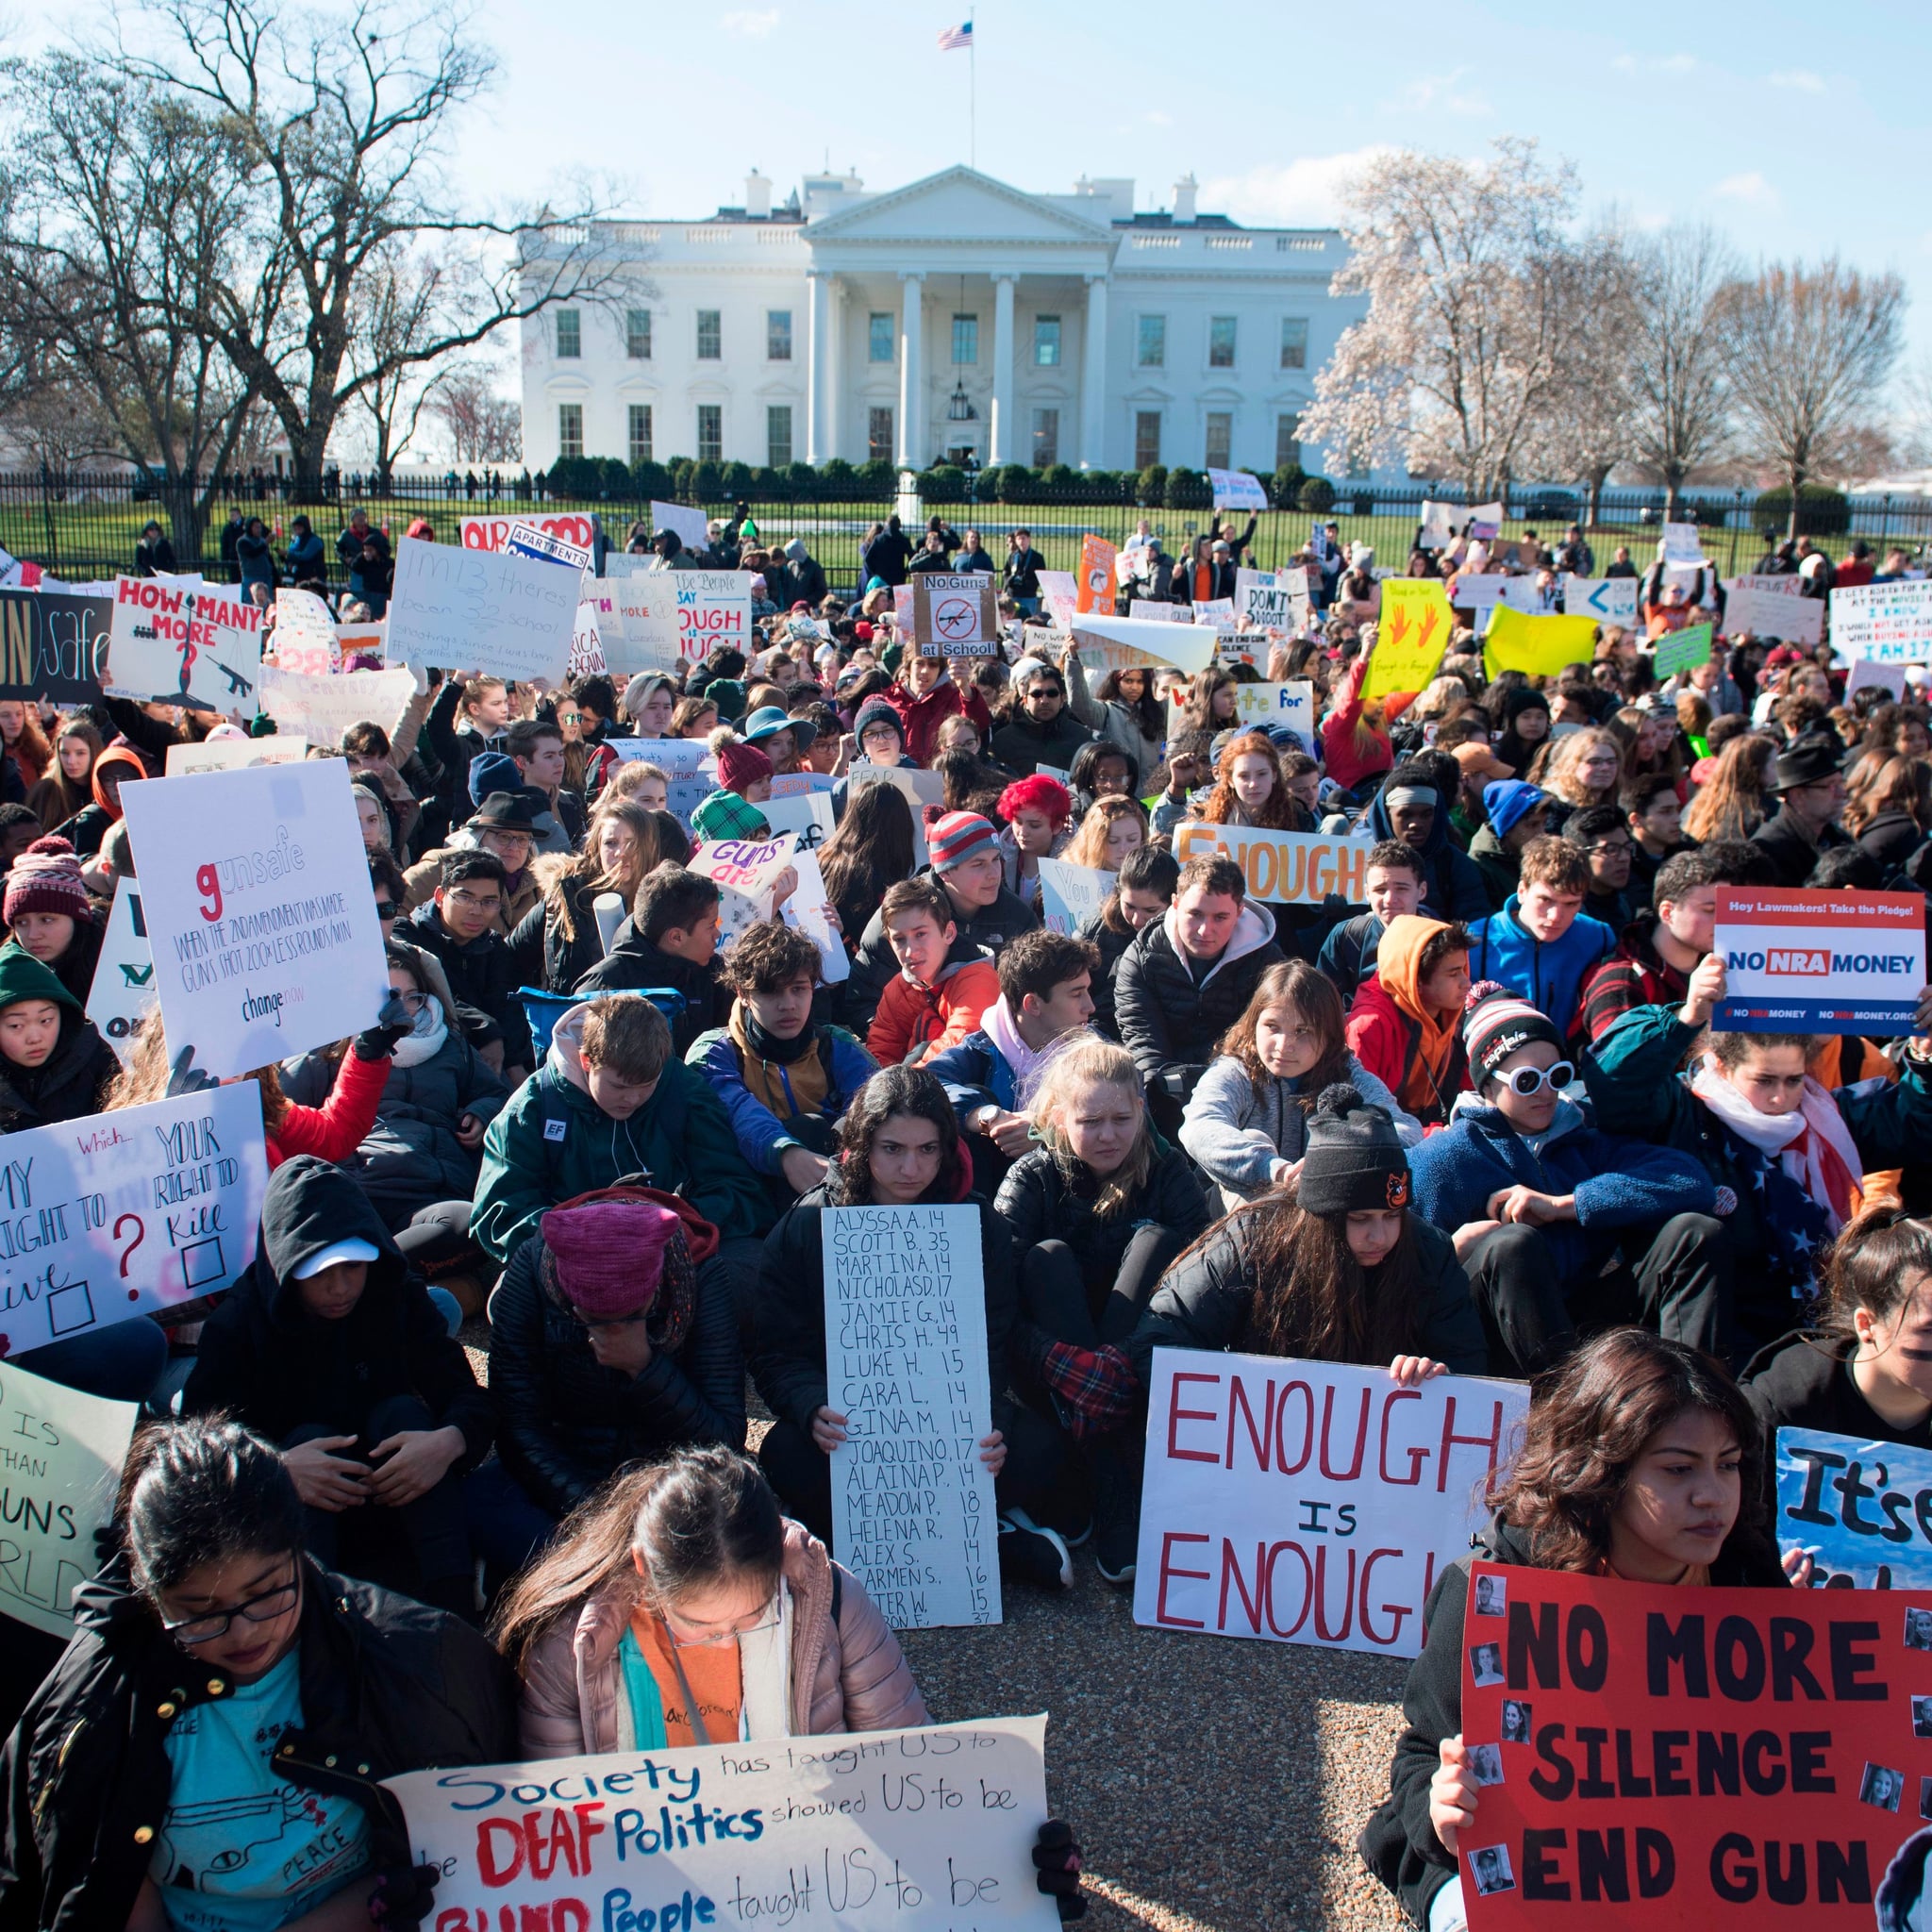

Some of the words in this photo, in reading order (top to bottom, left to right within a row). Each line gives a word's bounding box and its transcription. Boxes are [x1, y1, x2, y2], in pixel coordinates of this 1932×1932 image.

[464, 521, 508, 552] OUR
[514, 530, 586, 565] APARTMENTS
[498, 569, 569, 608] theres
[699, 574, 736, 592] People
[925, 576, 945, 589] No
[949, 577, 986, 589] Guns
[119, 579, 184, 614] HOW
[196, 595, 262, 633] MANY
[401, 589, 452, 614] been
[461, 596, 504, 625] 32
[509, 612, 558, 634] school
[620, 607, 649, 617] MORE
[677, 591, 696, 605] SAY
[1250, 590, 1288, 610] DON'T
[153, 614, 218, 647] MORE
[395, 625, 457, 650] shootings
[462, 636, 494, 652] since
[505, 647, 528, 658] was
[530, 648, 553, 663] born
[688, 629, 696, 638] IS
[176, 642, 198, 680] ?
[575, 651, 607, 674] AGAIN
[923, 645, 937, 656] at
[943, 643, 995, 655] School!
[1279, 688, 1304, 708] for
[631, 751, 662, 763] That's
[709, 863, 758, 887] are
[1055, 865, 1089, 904] You
[1729, 902, 1754, 914] Hey
[1757, 902, 1826, 914] Lawmakers!
[1830, 903, 1856, 915] Take
[1858, 904, 1875, 915] the
[1877, 906, 1913, 917] Pledge!
[174, 927, 208, 962] WHEN
[208, 922, 227, 950] THE
[181, 958, 218, 993] GUNS
[219, 948, 244, 979] SHOT
[1728, 951, 1766, 971] NO
[1770, 952, 1826, 974] NRA
[1832, 954, 1916, 974] MONEY
[1484, 1031, 1527, 1072] capitals
[156, 1117, 221, 1168] YOUR
[548, 1124, 564, 1134] EF
[153, 1162, 212, 1209] RIGHT
[216, 1158, 239, 1188] TO
[167, 1204, 228, 1247] Kill
[834, 1210, 903, 1233] ALYSSA
[929, 1209, 944, 1227] 14
[0, 1203, 69, 1260] IGHT
[76, 1192, 107, 1231] TO
[113, 1213, 144, 1302] ?
[833, 1231, 895, 1256] SCOTT
[928, 1231, 950, 1252] 35
[935, 1253, 951, 1273] 14
[937, 1274, 952, 1297] 17
[841, 1301, 911, 1325] JAMIE
[940, 1299, 957, 1322] 14
[840, 1324, 906, 1350] CHRIS
[937, 1324, 958, 1344] 49
[843, 1351, 894, 1377] LUKE
[941, 1349, 964, 1375] 15
[842, 1381, 902, 1407] CARA
[947, 1381, 967, 1405] 14
[13, 1410, 59, 1446] IS
[843, 1408, 914, 1436] GINA
[952, 1410, 974, 1434] 14
[955, 1438, 974, 1460] 17
[1167, 1372, 1503, 1513] ENOUGH
[846, 1463, 931, 1491] ALAINA
[958, 1462, 974, 1487] 14
[846, 1491, 922, 1518] MEADOW
[959, 1491, 980, 1514] 18
[1787, 1448, 1913, 1543] It's
[0, 1487, 77, 1540] UNS
[1298, 1500, 1357, 1537] IS
[848, 1518, 922, 1543] HELENA
[963, 1515, 980, 1539] 17
[850, 1543, 895, 1566] ALEX
[963, 1540, 980, 1562] 14
[965, 1566, 987, 1588] 16
[971, 1588, 988, 1611] 15
[972, 1613, 990, 1624] 37
[1507, 1601, 1608, 1693] NO
[1645, 1612, 1890, 1702] MORE
[437, 1758, 700, 1811] Society
[722, 1754, 770, 1775] has
[777, 1739, 895, 1774] taught
[899, 1733, 960, 1757] US
[968, 1732, 997, 1749] to
[1528, 1722, 1837, 1802] SILENCE
[475, 1802, 607, 1889] DEAF
[614, 1803, 764, 1862] Politics
[772, 1790, 867, 1824] showed
[882, 1772, 924, 1812] US
[930, 1777, 963, 1809] to
[980, 1777, 1019, 1810] be
[283, 1826, 351, 1882] PEACE
[1522, 1826, 1675, 1903] END
[1708, 1831, 1873, 1906] GUN
[602, 1888, 716, 1932] People
[727, 1864, 815, 1926] taught
[824, 1846, 877, 1912] US
[884, 1858, 923, 1910] to
[948, 1857, 1001, 1907] be
